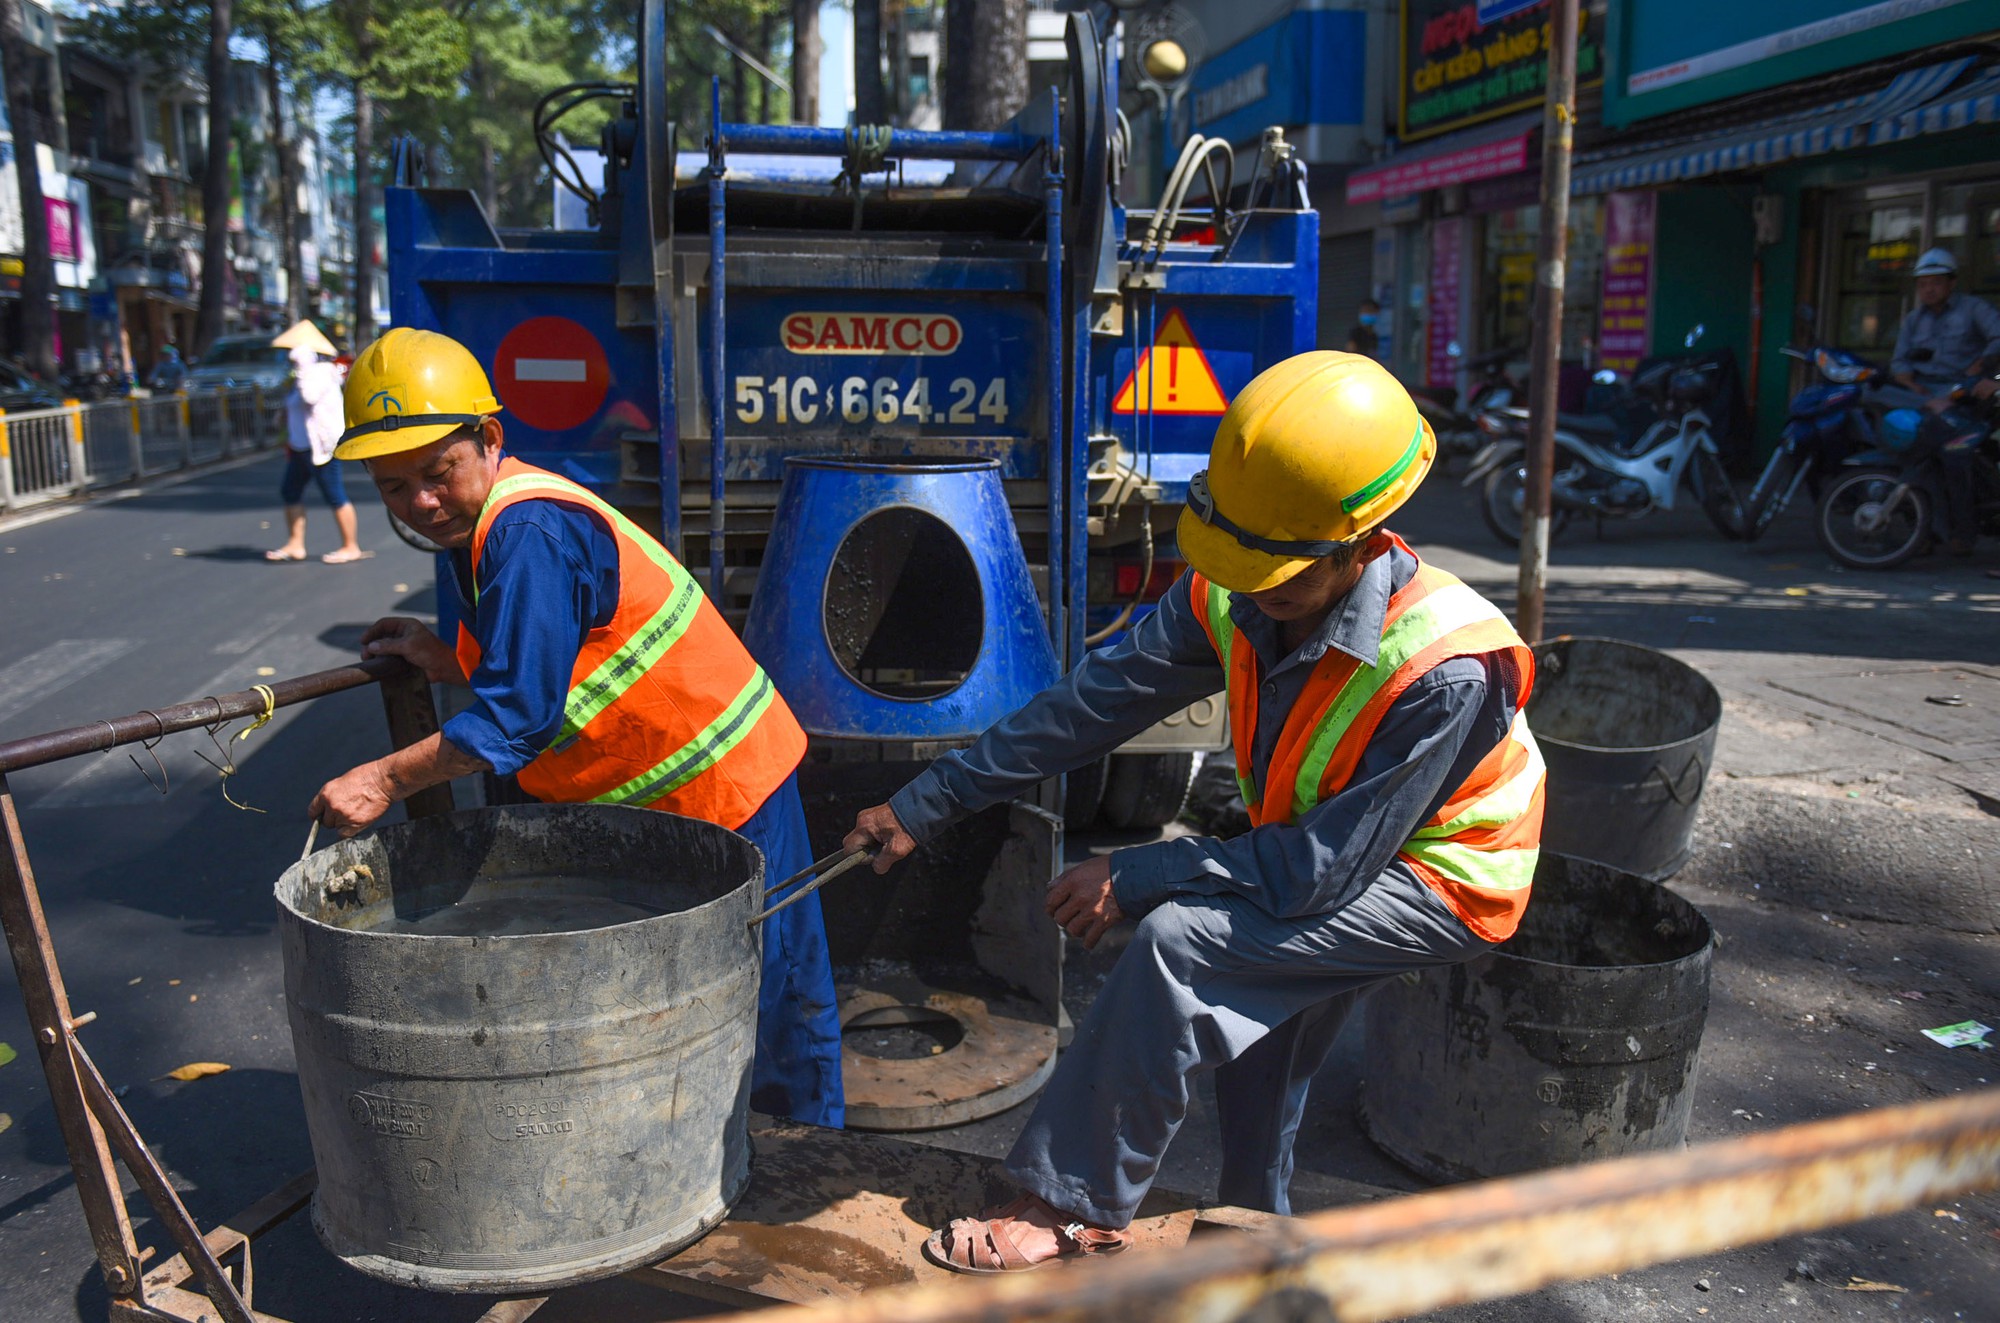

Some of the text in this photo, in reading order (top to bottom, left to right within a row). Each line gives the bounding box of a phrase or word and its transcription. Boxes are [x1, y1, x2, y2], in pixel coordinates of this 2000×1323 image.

[786, 316, 959, 352] SAMCO
[735, 376, 1009, 423] 51C 664.24
[515, 1119, 574, 1138] SANKO
